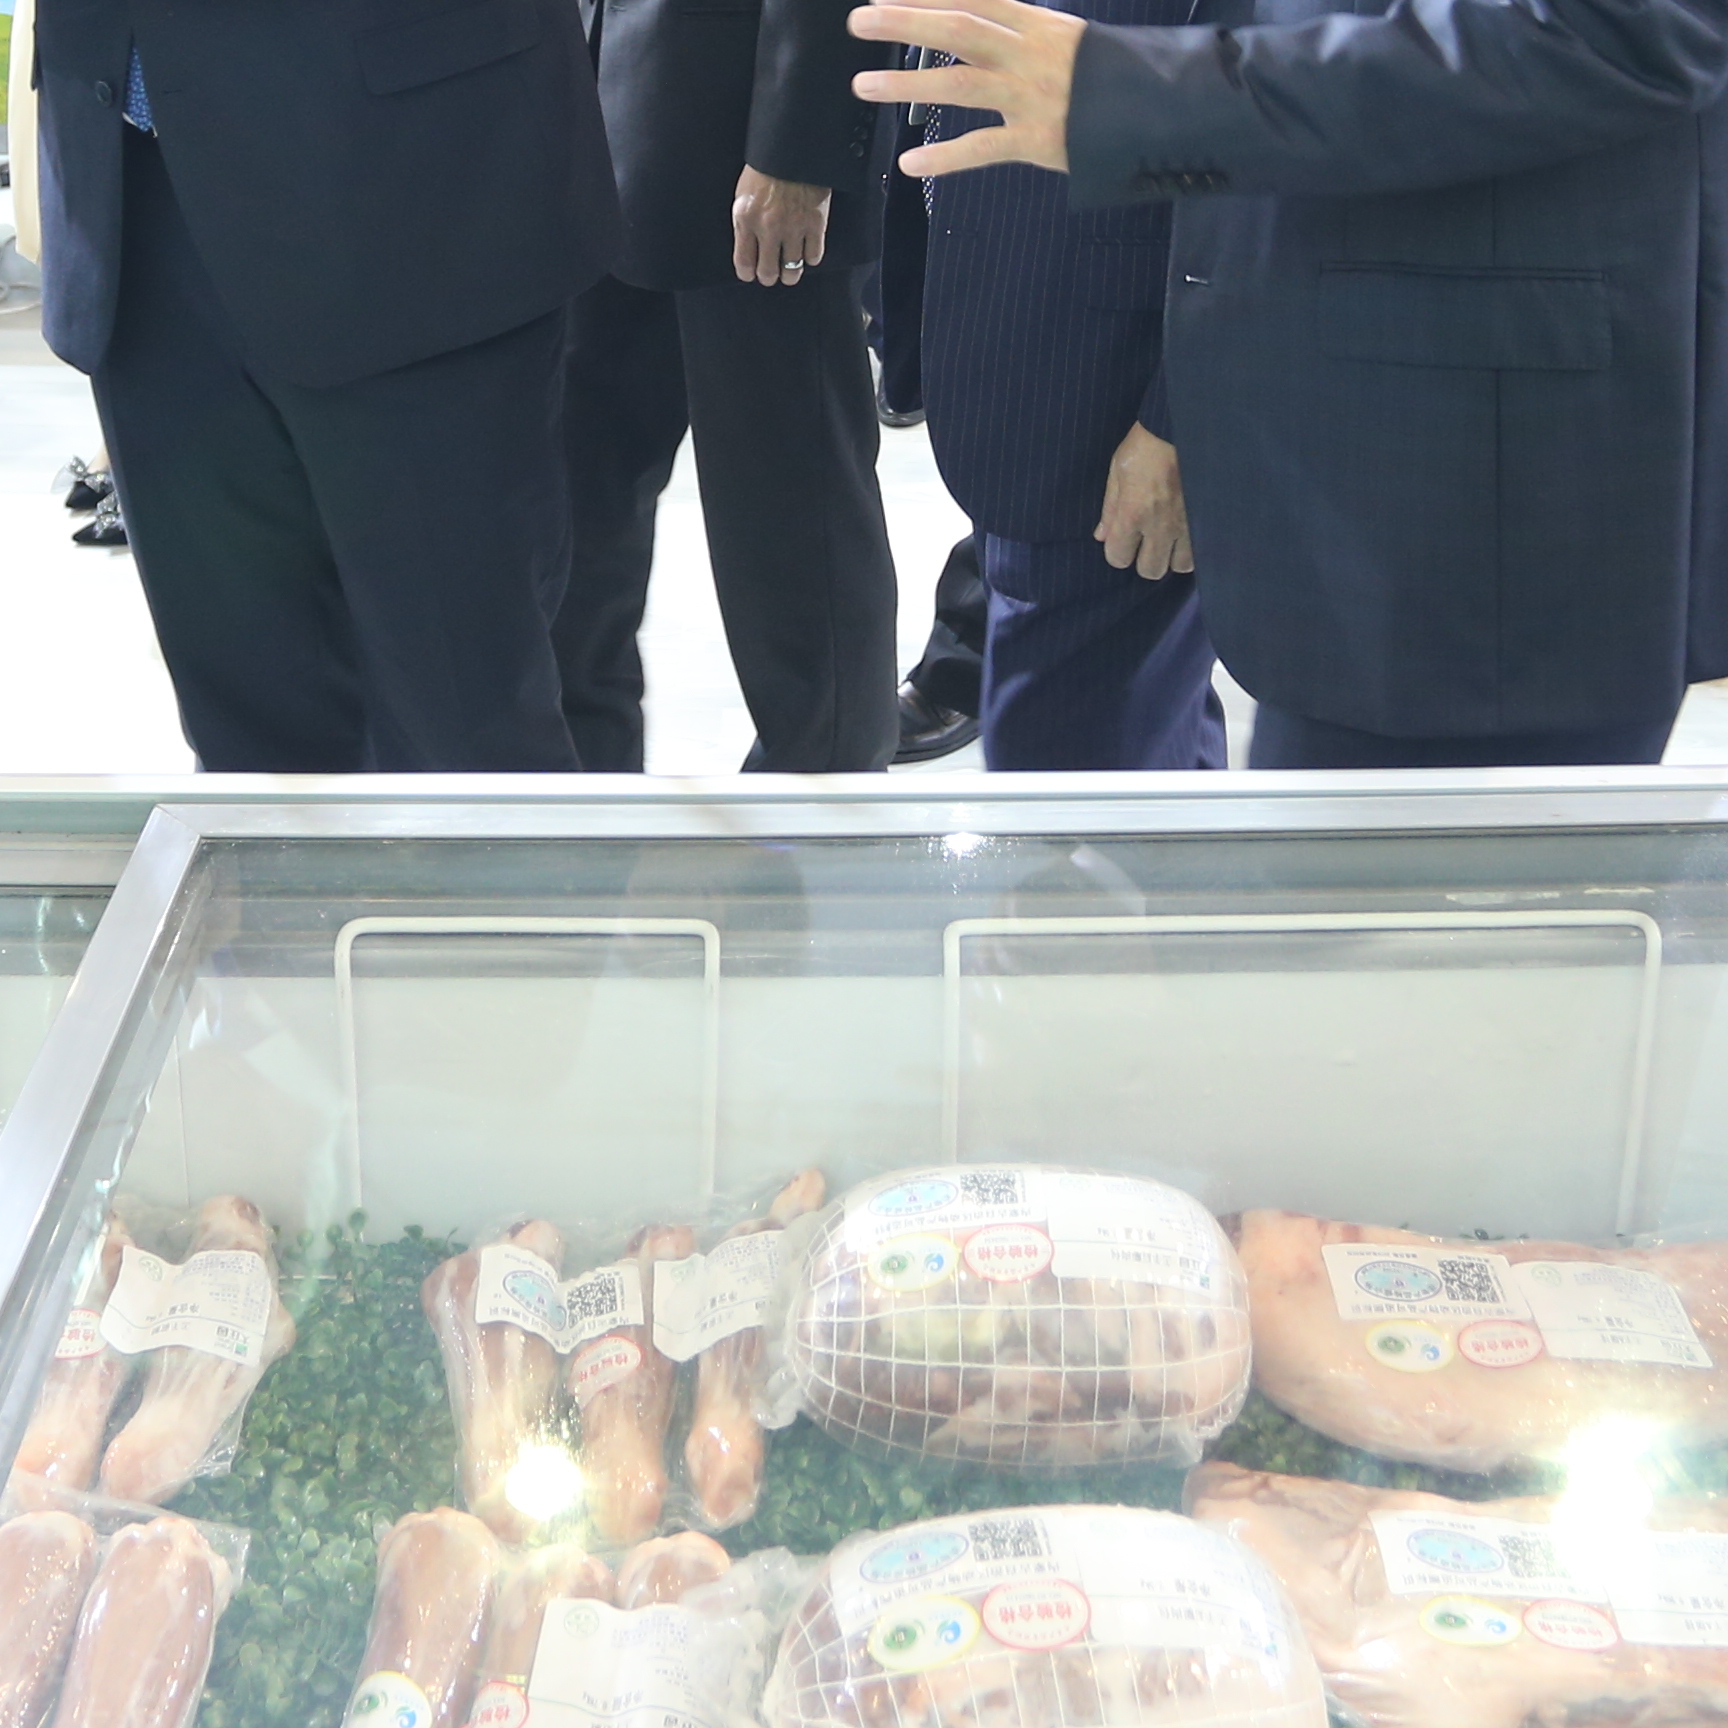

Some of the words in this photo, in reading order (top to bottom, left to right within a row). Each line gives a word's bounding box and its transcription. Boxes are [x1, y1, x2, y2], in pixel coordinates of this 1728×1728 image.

[977, 1244, 1039, 1260] 检验合格
[168, 1302, 200, 1316] 净含量
[61, 1328, 96, 1342] 检验
[216, 1326, 250, 1344] 大庄园
[1470, 1337, 1529, 1353] 检验合格
[1689, 1595, 1726, 1611] 净含量
[998, 1602, 1072, 1625] 检验合格
[1537, 1618, 1604, 1638] 检验合格
